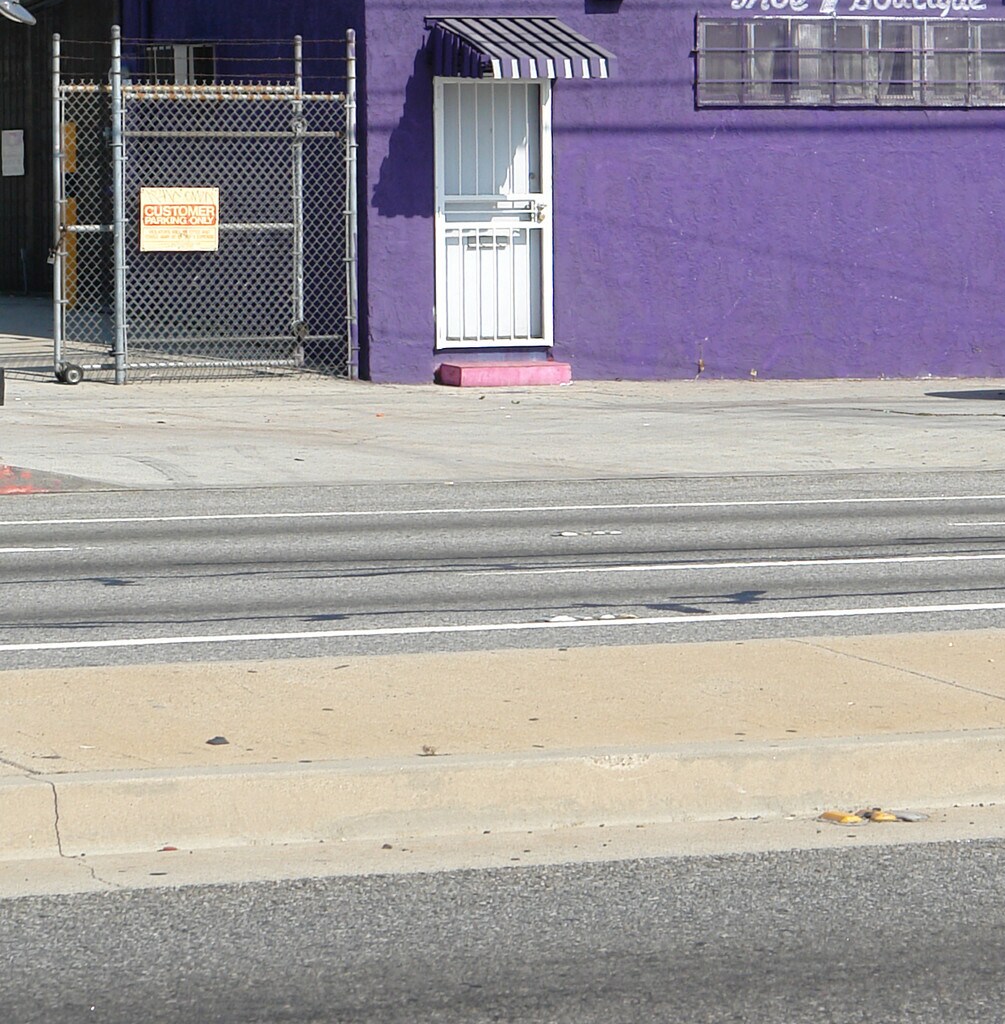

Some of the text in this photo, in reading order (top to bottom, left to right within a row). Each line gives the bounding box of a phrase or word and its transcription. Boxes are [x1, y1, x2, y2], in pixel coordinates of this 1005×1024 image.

[144, 206, 215, 217] CUSTOMER
[144, 216, 215, 225] PARKING ONLY
